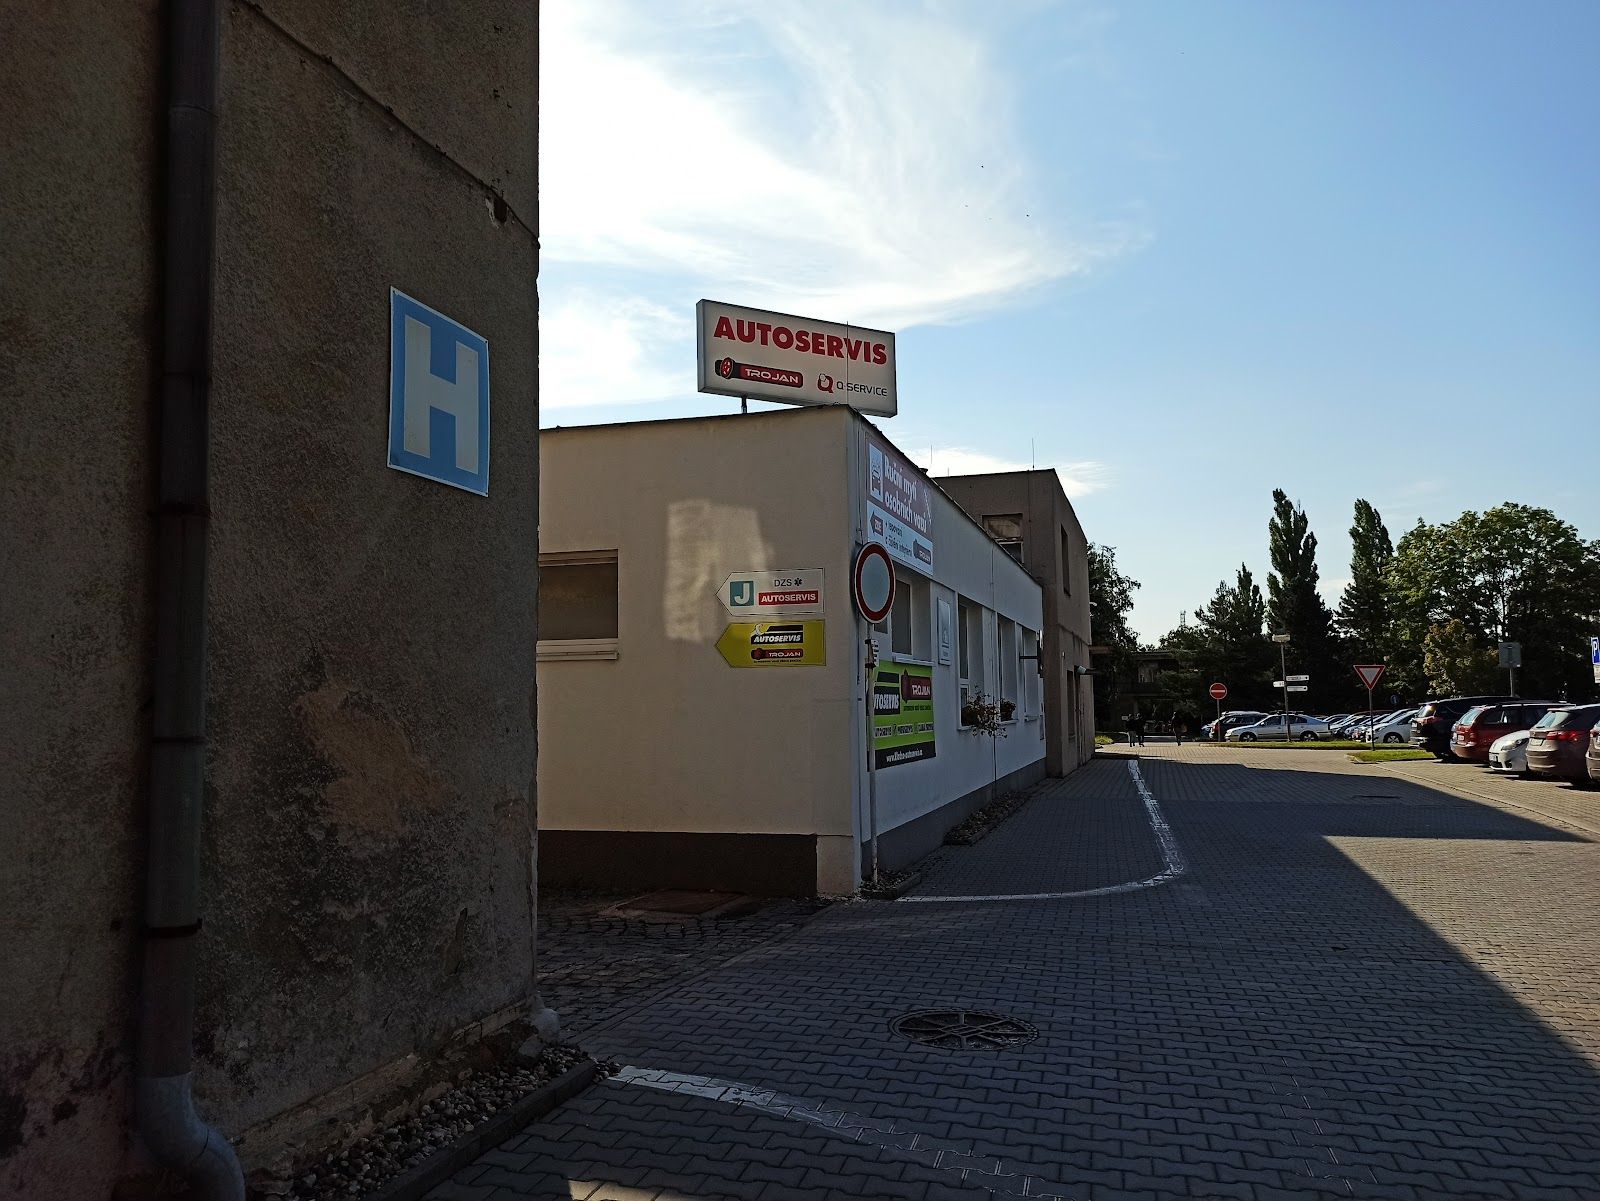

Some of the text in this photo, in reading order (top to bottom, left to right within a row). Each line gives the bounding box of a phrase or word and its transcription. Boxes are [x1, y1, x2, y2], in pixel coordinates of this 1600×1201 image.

[713, 315, 887, 365] AUTOSERVIS
[745, 368, 799, 384] TROJAN
[404, 314, 479, 475] H
[774, 579, 792, 587] DZS
[734, 582, 750, 605] J
[761, 593, 816, 603] AUTOSERVIS
[753, 634, 801, 643] AUTOSERVIS
[1592, 640, 1597, 656] P
[911, 684, 931, 696] TROJAN
